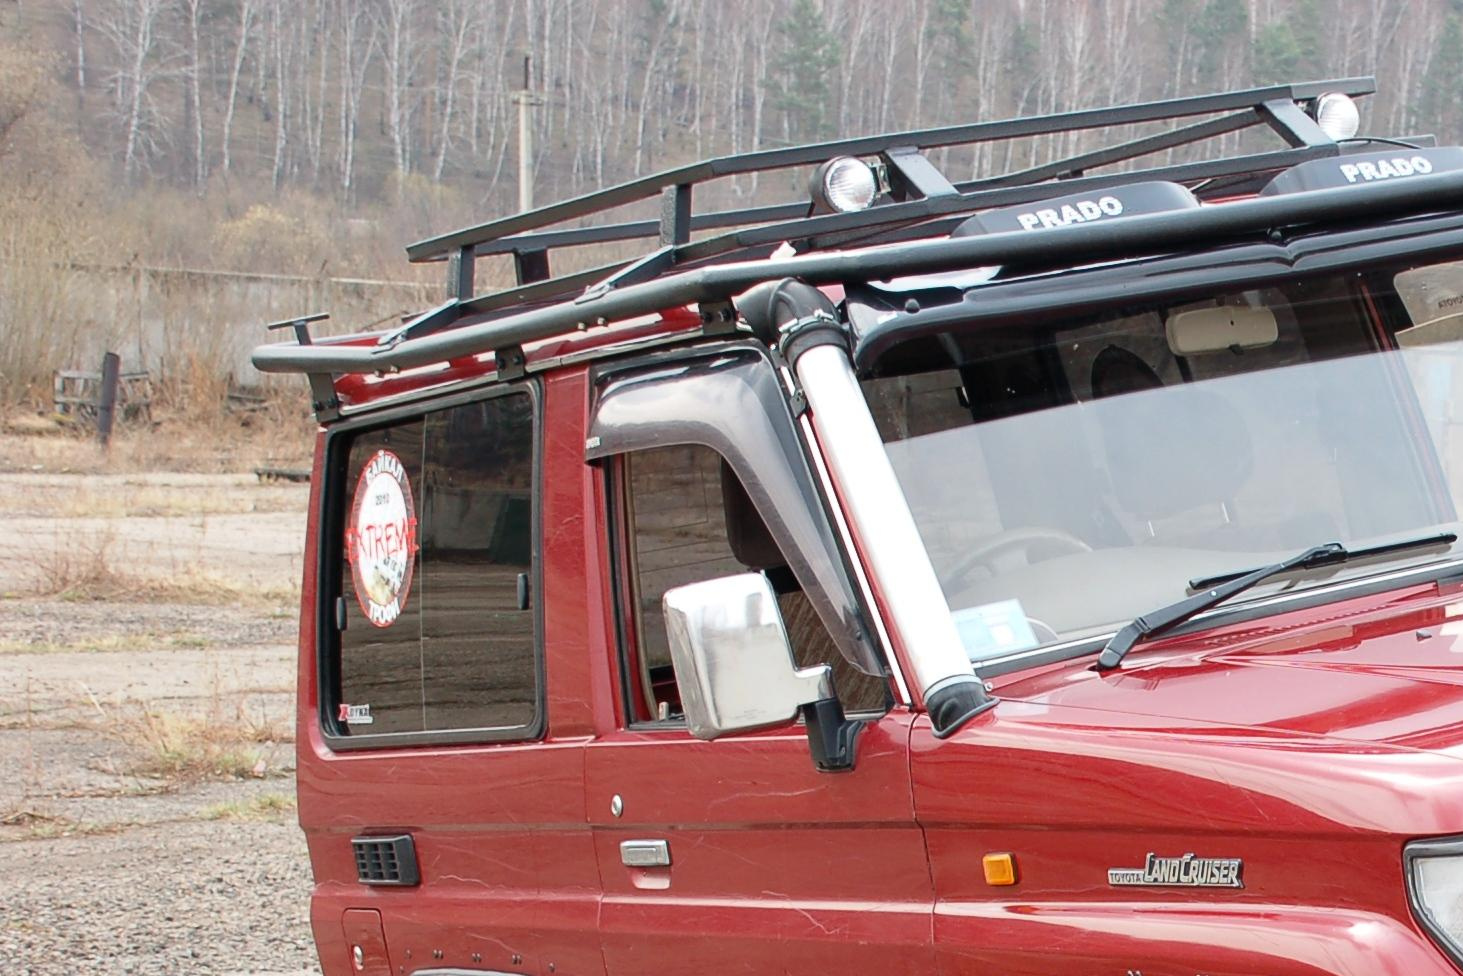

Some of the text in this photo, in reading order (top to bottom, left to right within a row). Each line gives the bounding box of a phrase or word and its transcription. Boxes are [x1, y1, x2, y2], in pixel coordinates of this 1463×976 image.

[1339, 156, 1433, 184] PRADO
[1016, 196, 1124, 232] PRADO
[1109, 872, 1142, 883] TOYOTA
